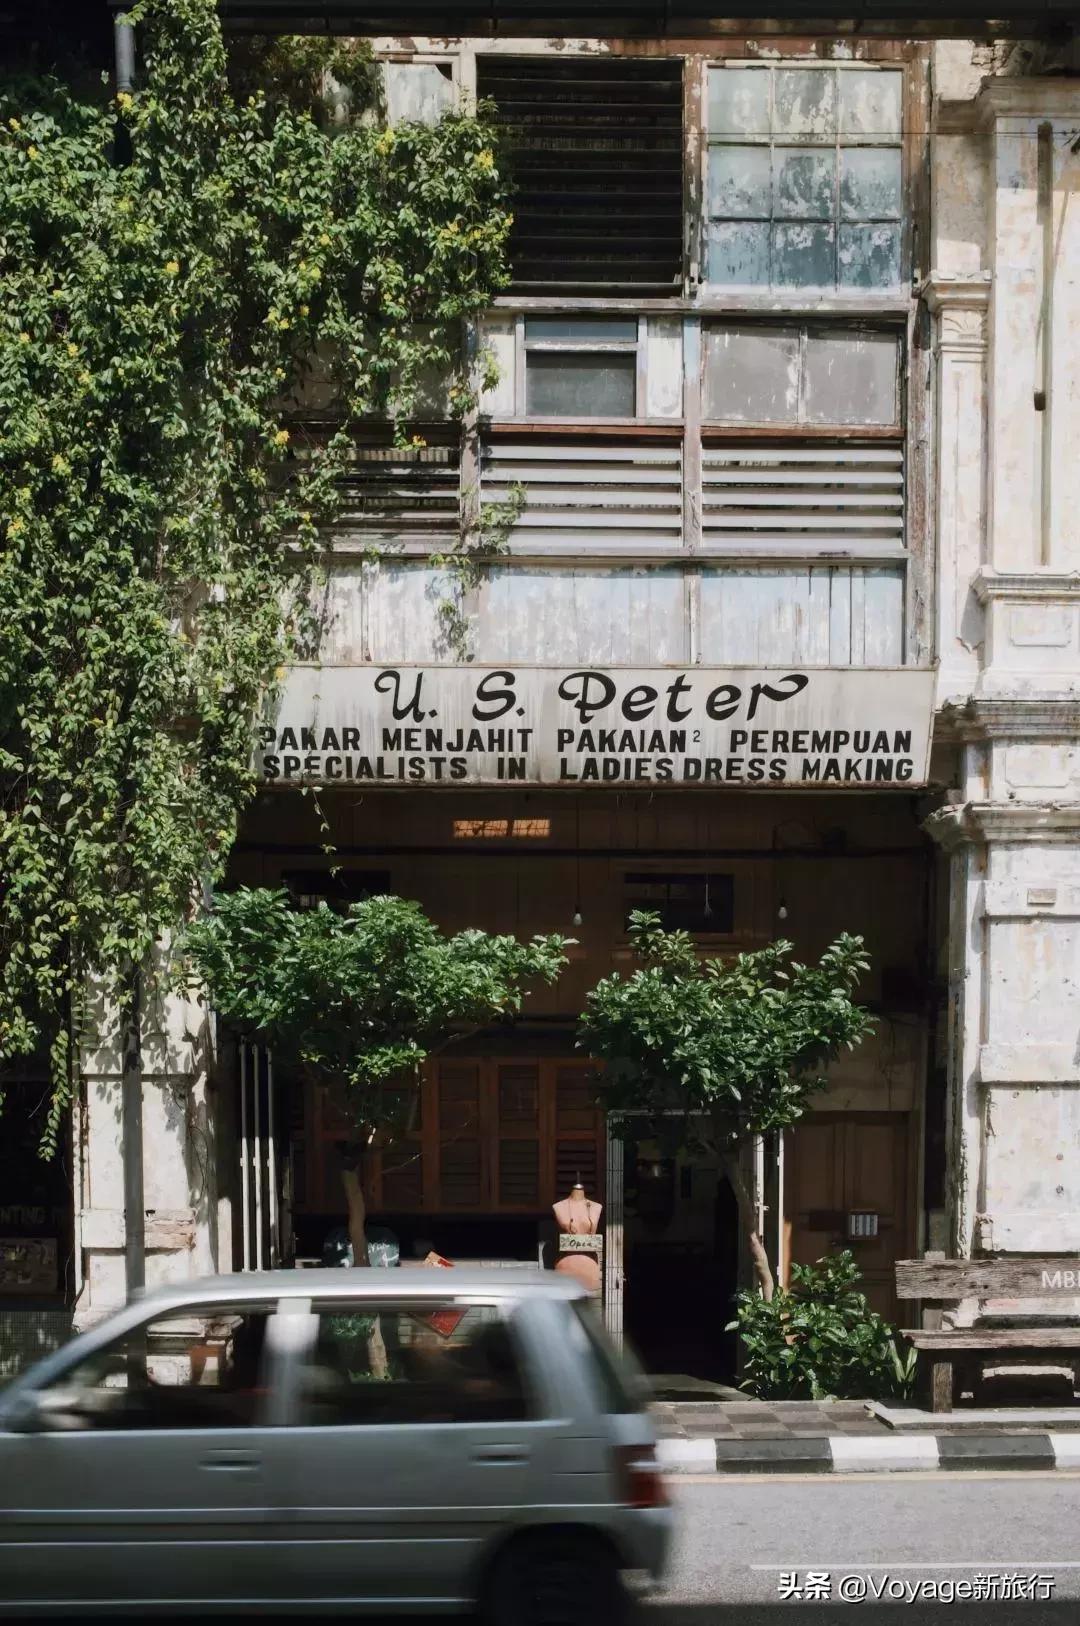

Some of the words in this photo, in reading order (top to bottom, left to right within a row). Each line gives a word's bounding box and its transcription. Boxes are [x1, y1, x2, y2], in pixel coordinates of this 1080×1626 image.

[374, 670, 438, 723] U.
[472, 670, 526, 721] S.
[558, 671, 809, 724] Peter
[259, 726, 361, 750] PAKAR
[382, 728, 533, 752] MENJAHIT
[730, 730, 912, 754] PEREMPUAN
[263, 755, 468, 779] SPECIALISTS
[497, 757, 527, 780] IN
[560, 758, 674, 781] LADIES
[683, 758, 788, 781] DRESS
[802, 759, 914, 782] MAKING
